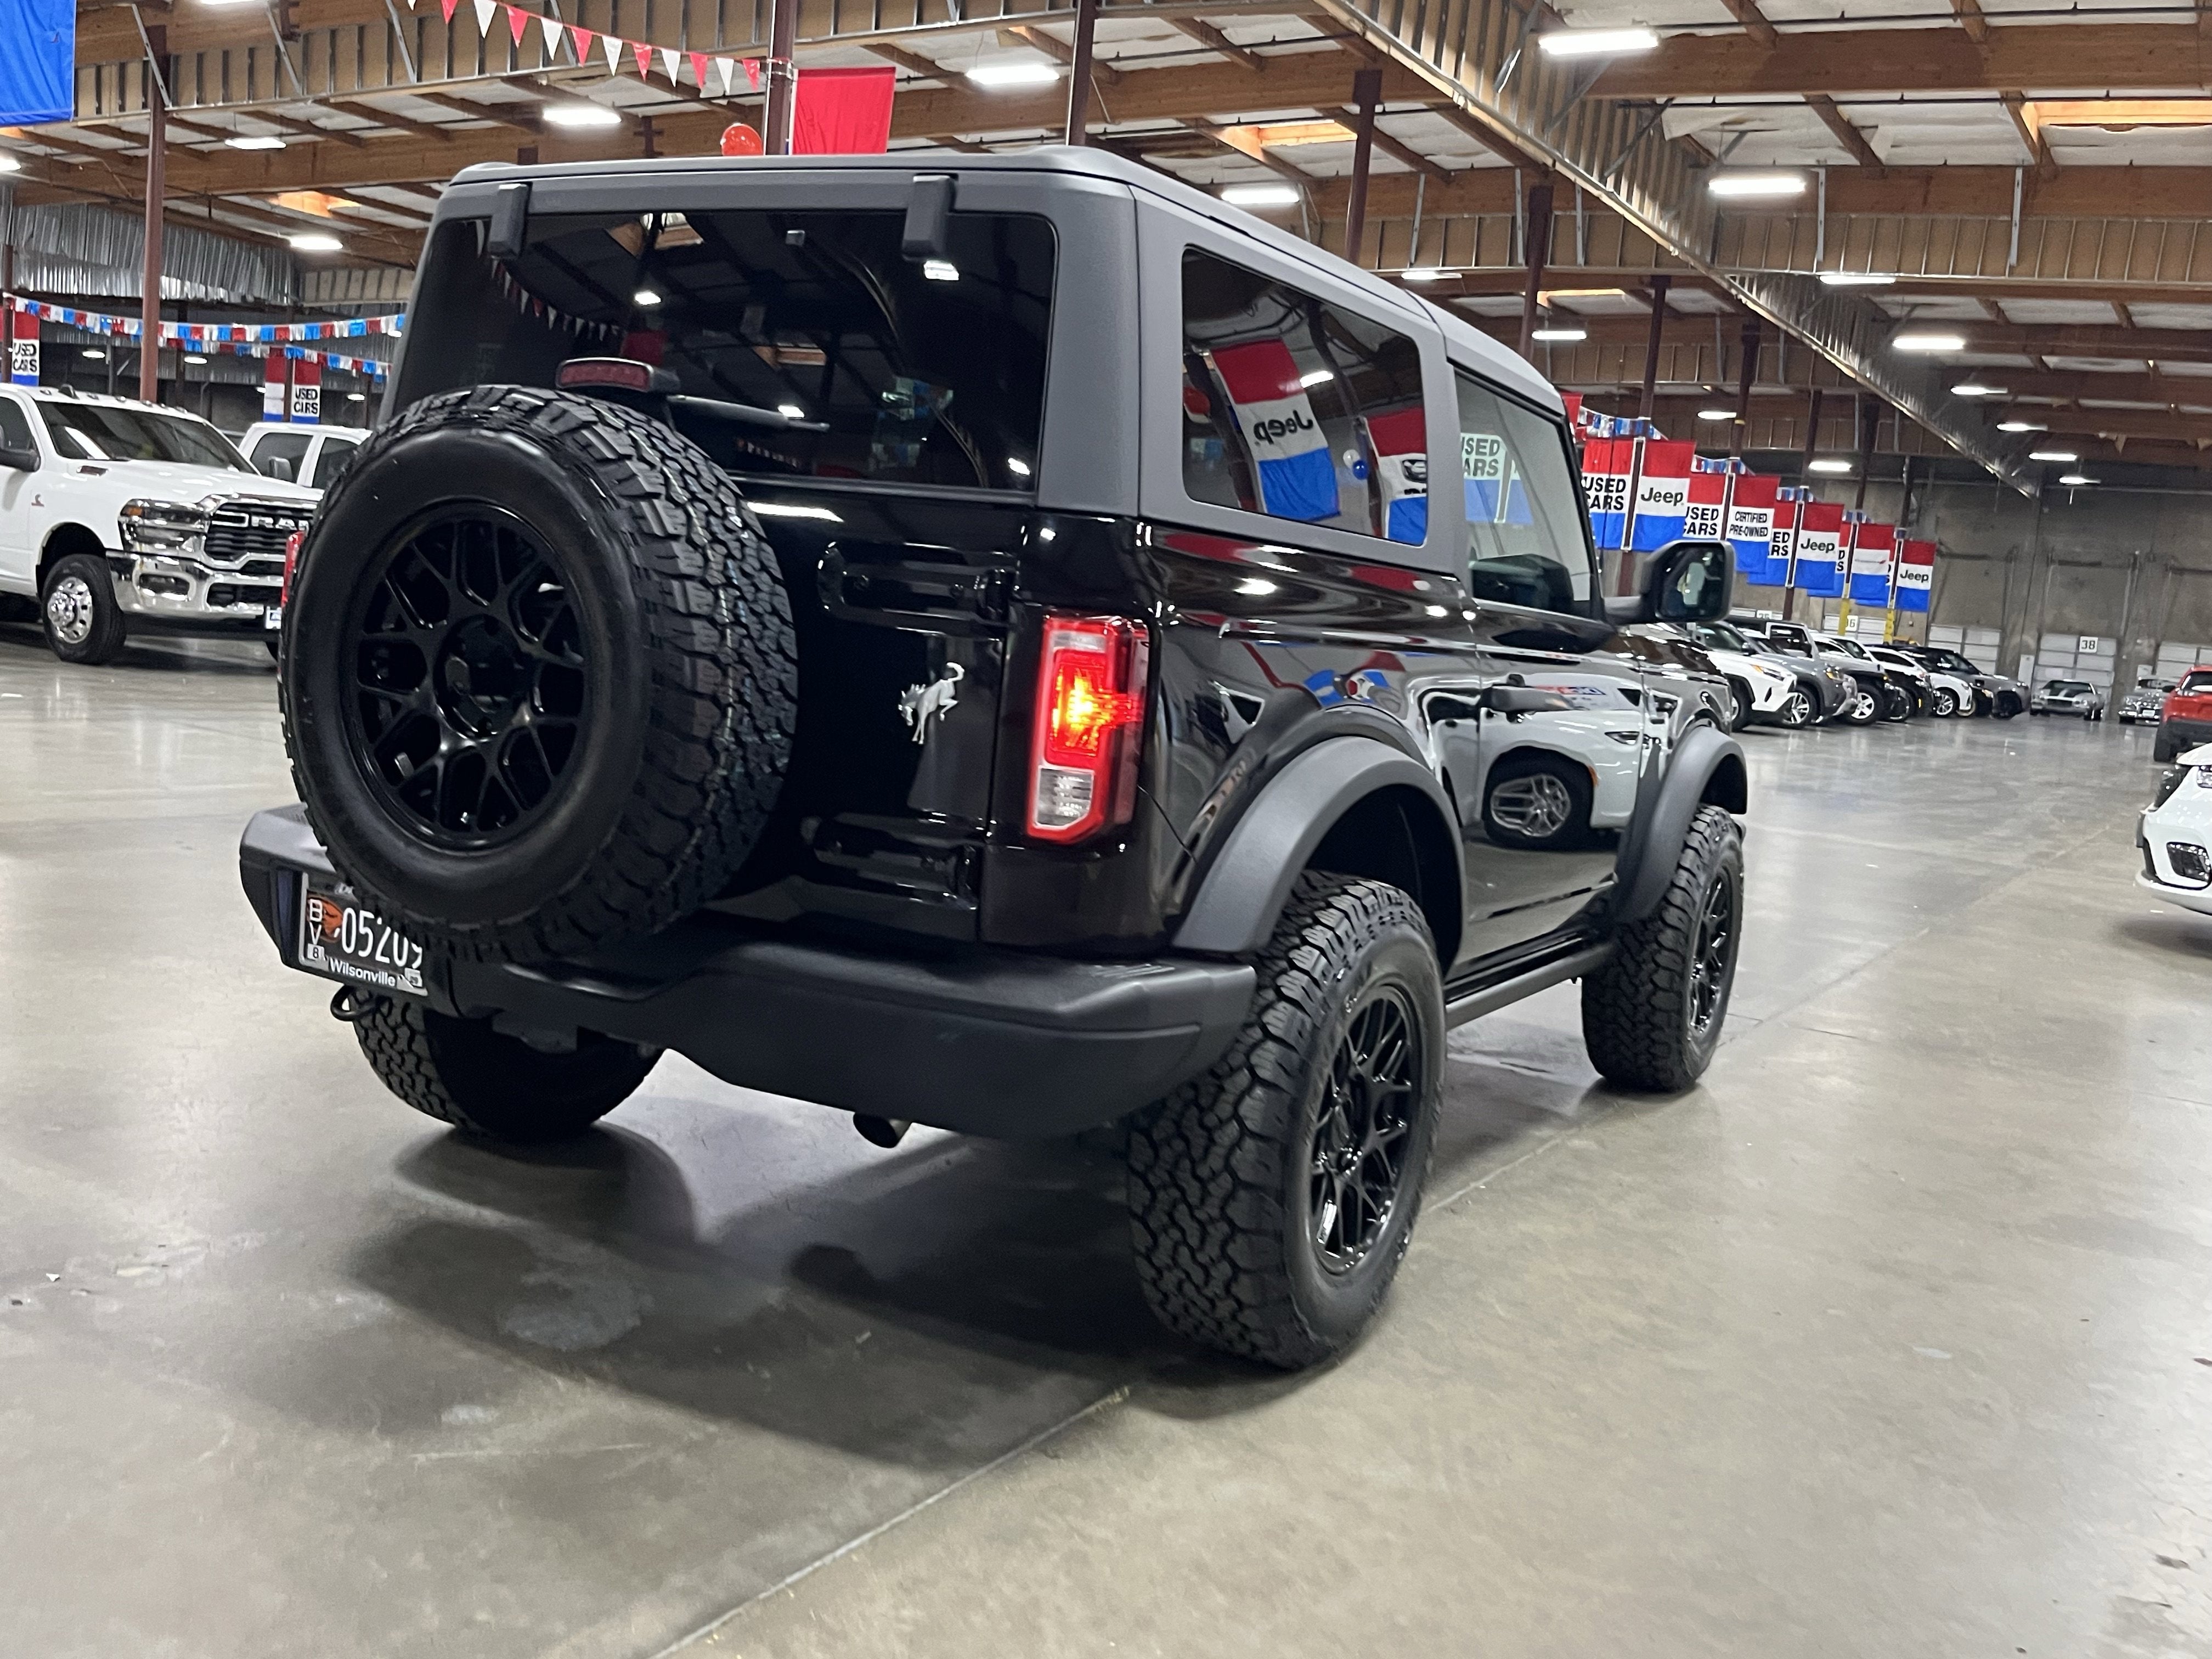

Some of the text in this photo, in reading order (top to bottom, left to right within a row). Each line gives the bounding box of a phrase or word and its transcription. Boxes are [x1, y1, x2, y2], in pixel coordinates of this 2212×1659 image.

[295, 388, 318, 400] USED
[1464, 458, 1499, 477] ARS
[1583, 476, 1626, 493] USED
[1640, 487, 1683, 506] Jeep
[1735, 511, 1767, 523] CERTIFIED
[1729, 523, 1768, 537] PRE-OWNED
[1801, 538, 1835, 554] Jeep
[1900, 569, 1929, 583] Jeep
[2081, 640, 2096, 650] 38
[330, 957, 396, 986] Wilsonville
